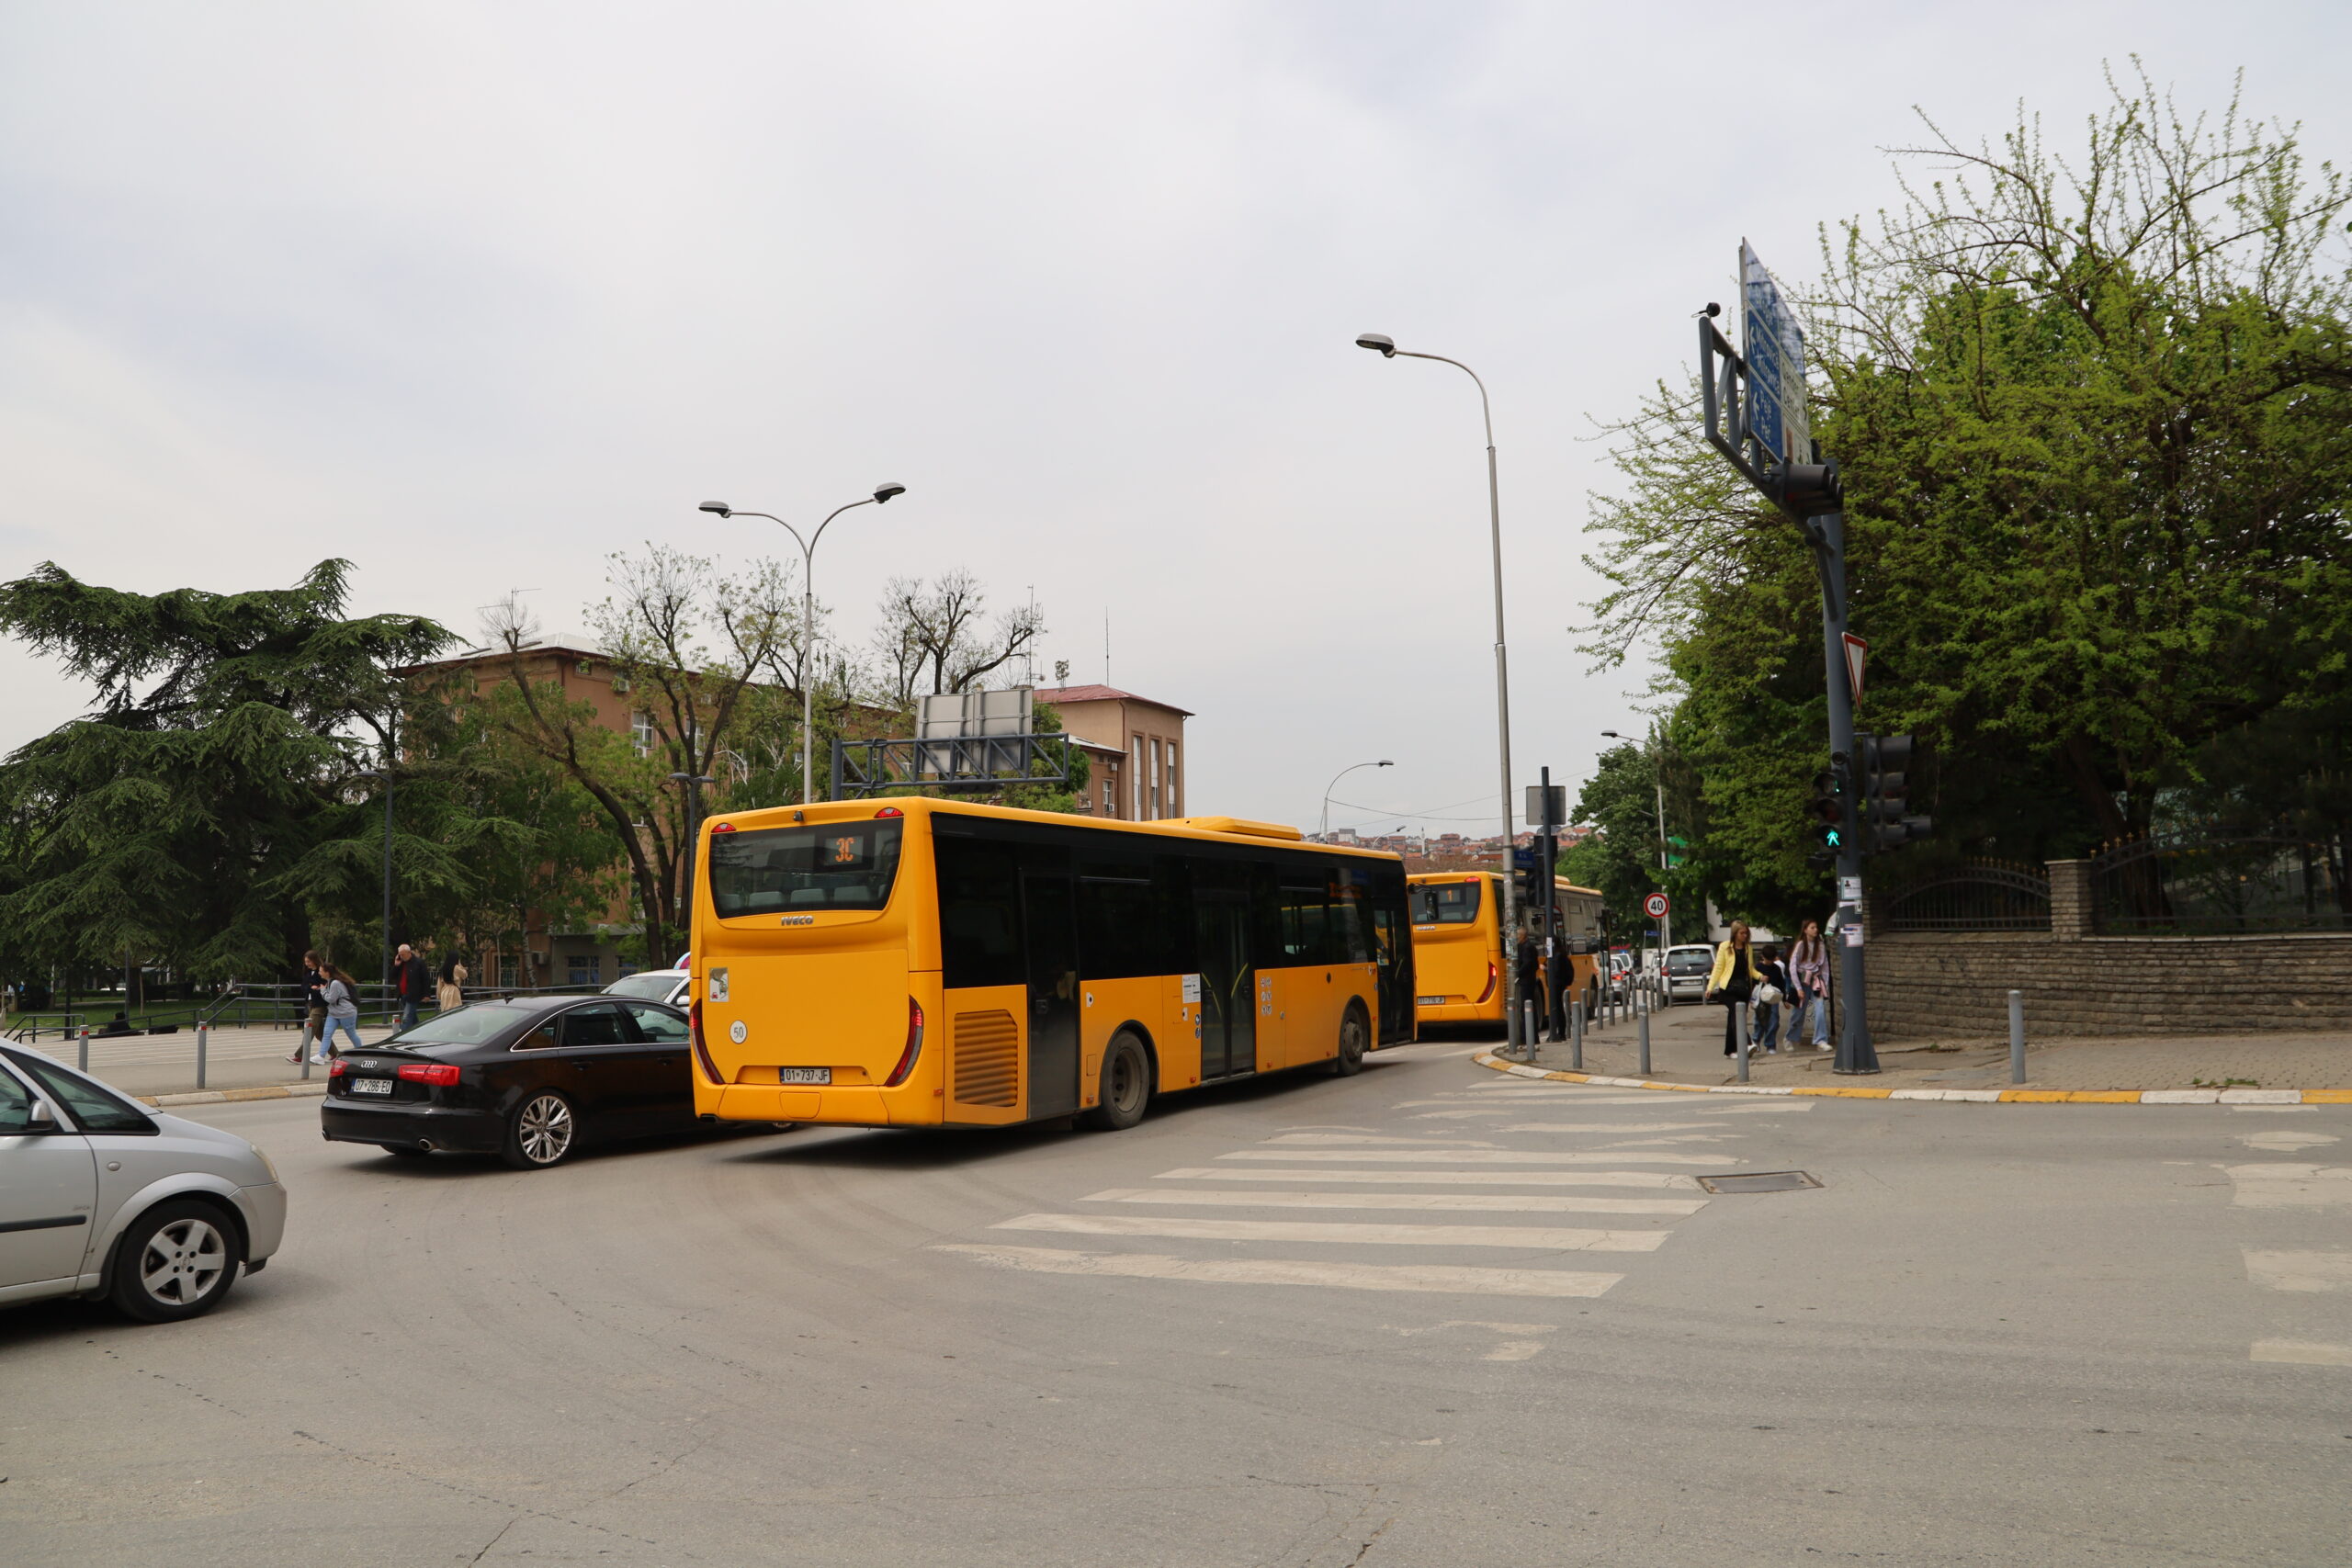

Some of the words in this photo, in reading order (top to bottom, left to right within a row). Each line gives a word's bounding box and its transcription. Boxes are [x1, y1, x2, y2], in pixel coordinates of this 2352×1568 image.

[835, 838, 854, 863] 3C
[1650, 900, 1664, 911] 40
[781, 915, 814, 927] IVECO
[733, 1026, 744, 1039] 50
